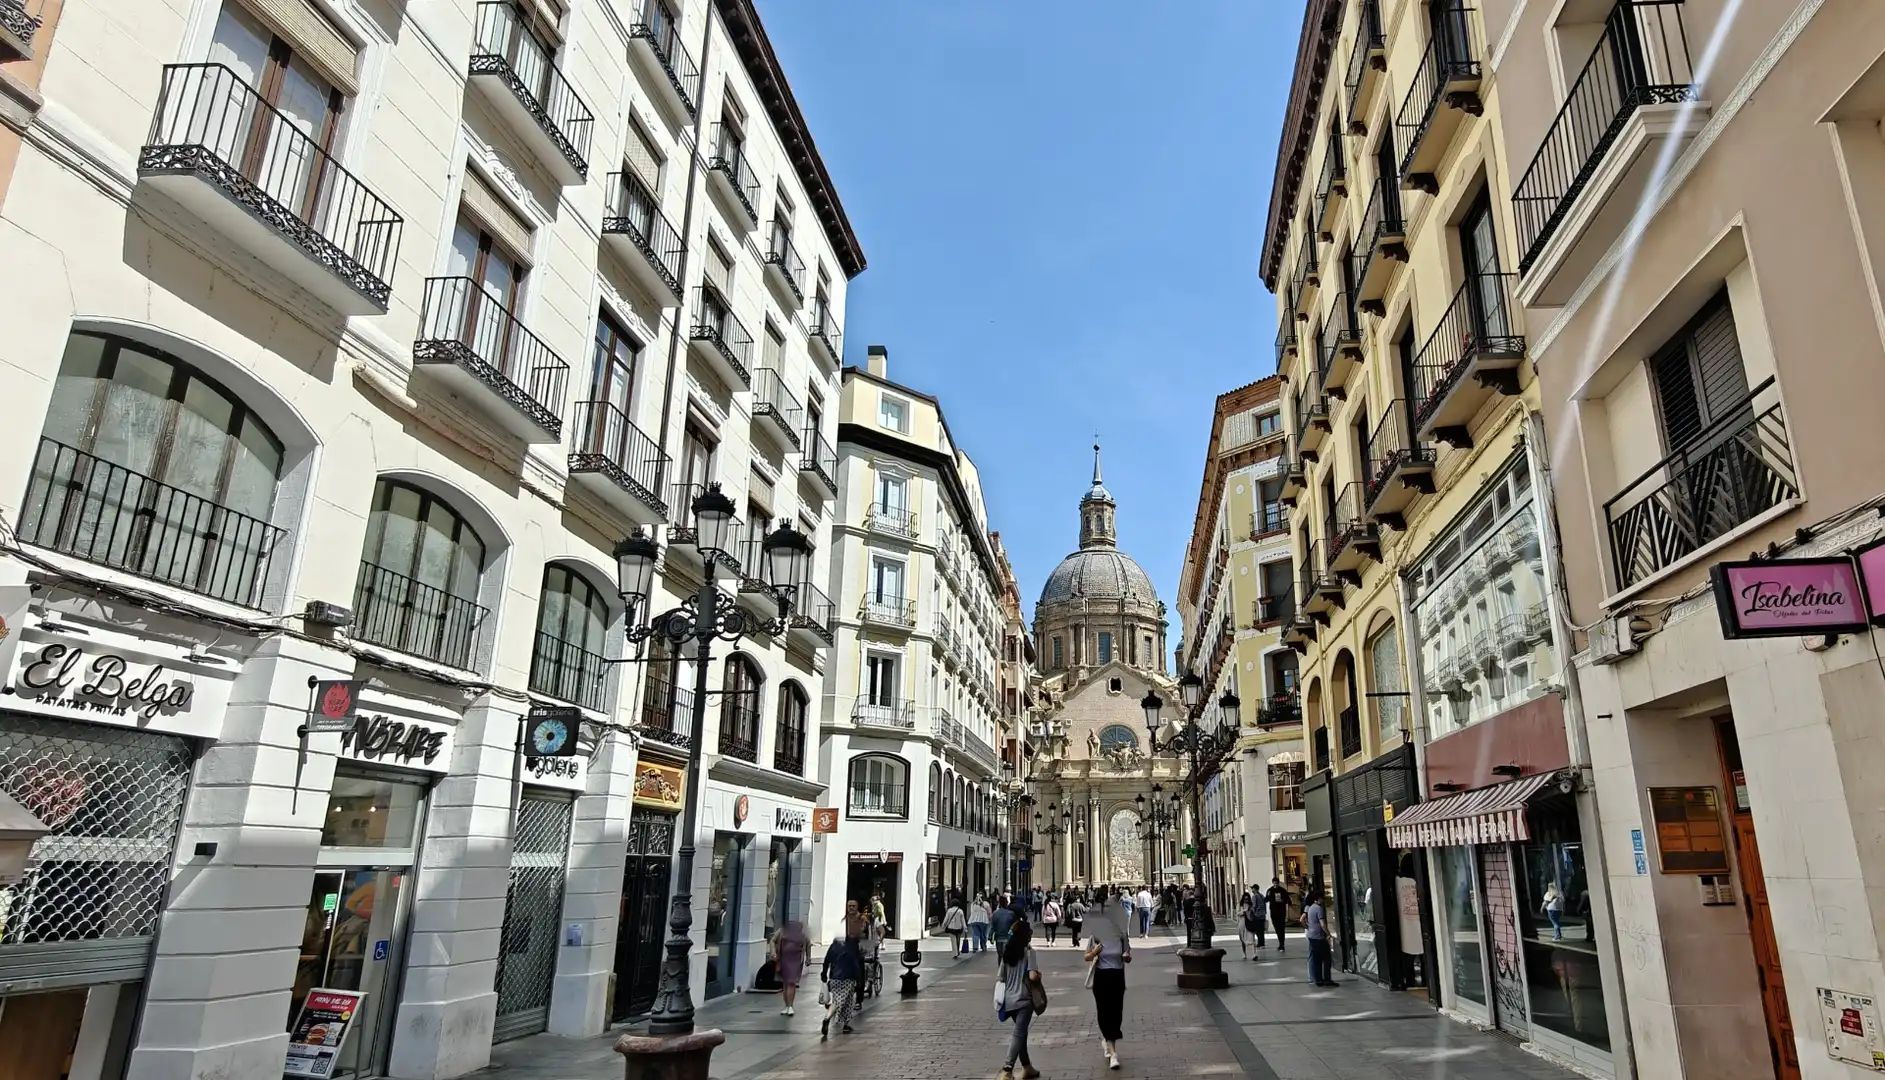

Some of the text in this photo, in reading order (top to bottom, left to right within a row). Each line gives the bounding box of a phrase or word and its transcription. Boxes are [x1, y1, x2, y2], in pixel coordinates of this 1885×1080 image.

[1742, 580, 1845, 617] Isabelina
[23, 643, 193, 719] El Belga
[35, 694, 127, 717] PATATAS FRITAS
